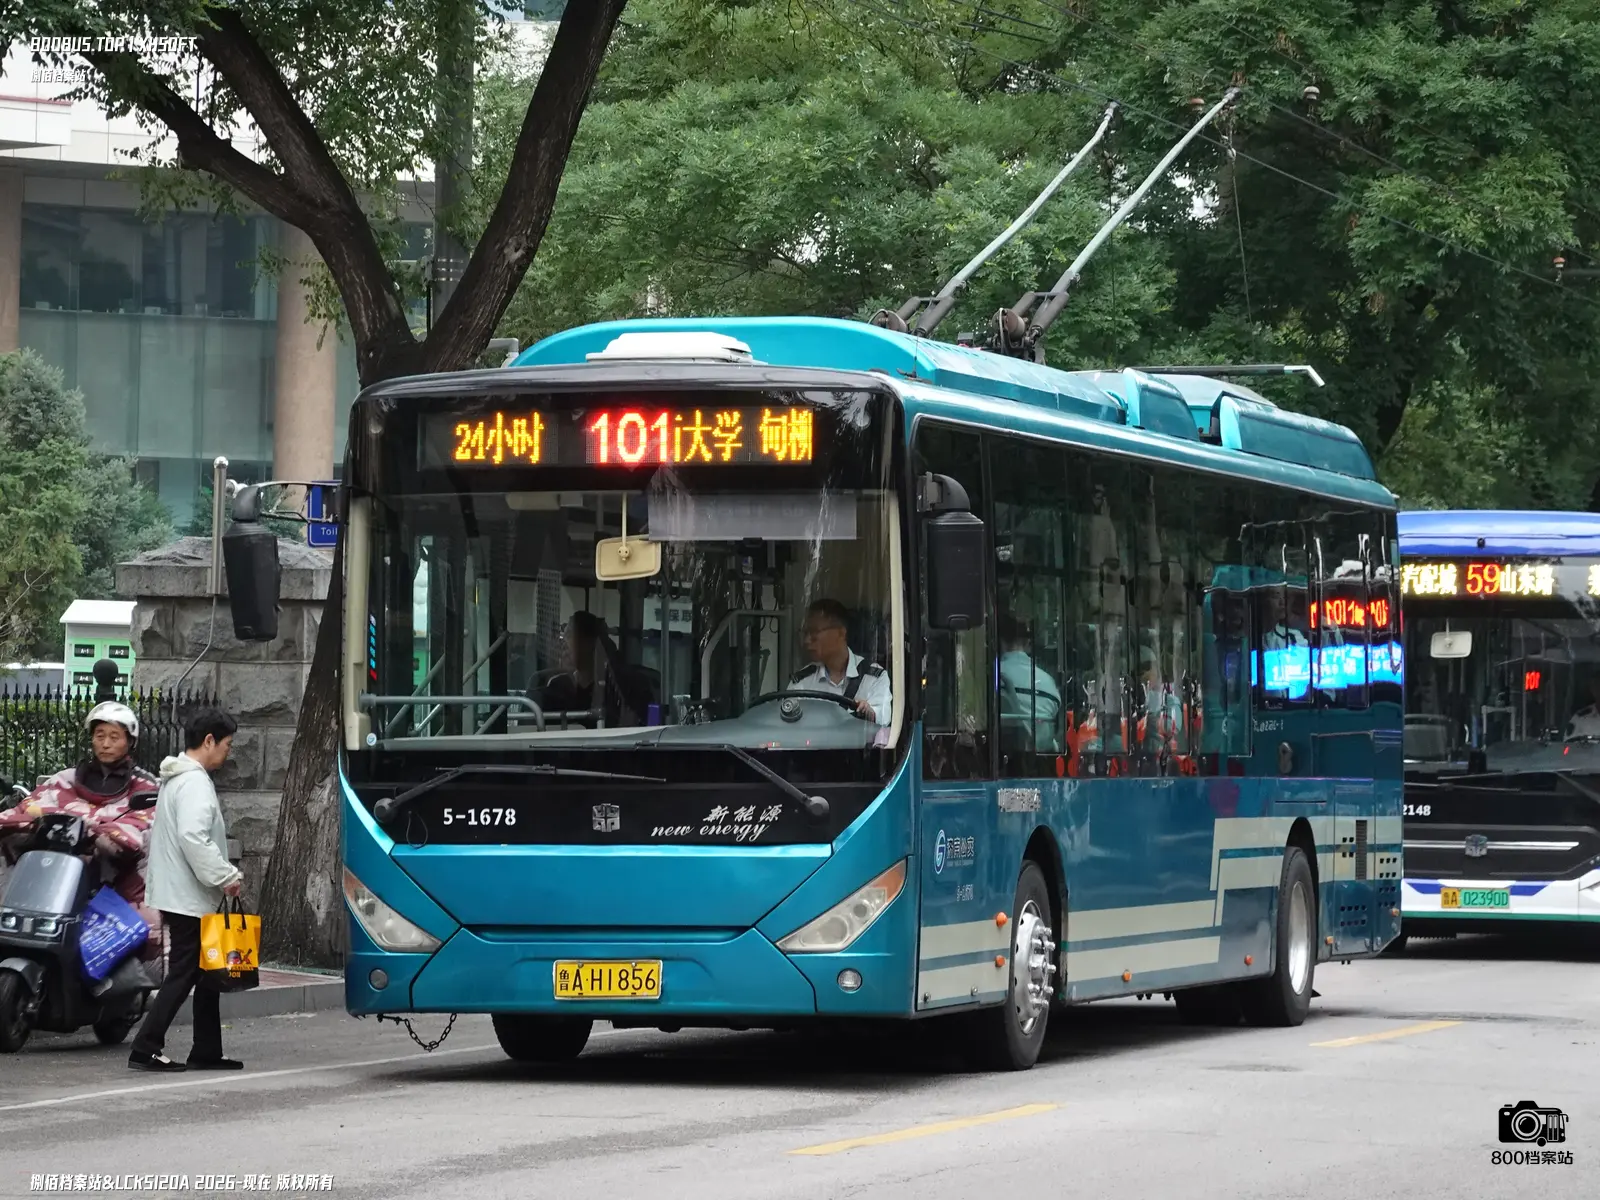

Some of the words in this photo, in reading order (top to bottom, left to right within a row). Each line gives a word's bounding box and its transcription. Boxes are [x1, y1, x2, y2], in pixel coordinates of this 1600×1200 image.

[591, 412, 668, 463] 101
[1466, 563, 1500, 595] 59
[443, 808, 517, 826] 5-1678
[702, 804, 783, 824] 新能源
[650, 825, 695, 837] new
[699, 823, 771, 842] energy
